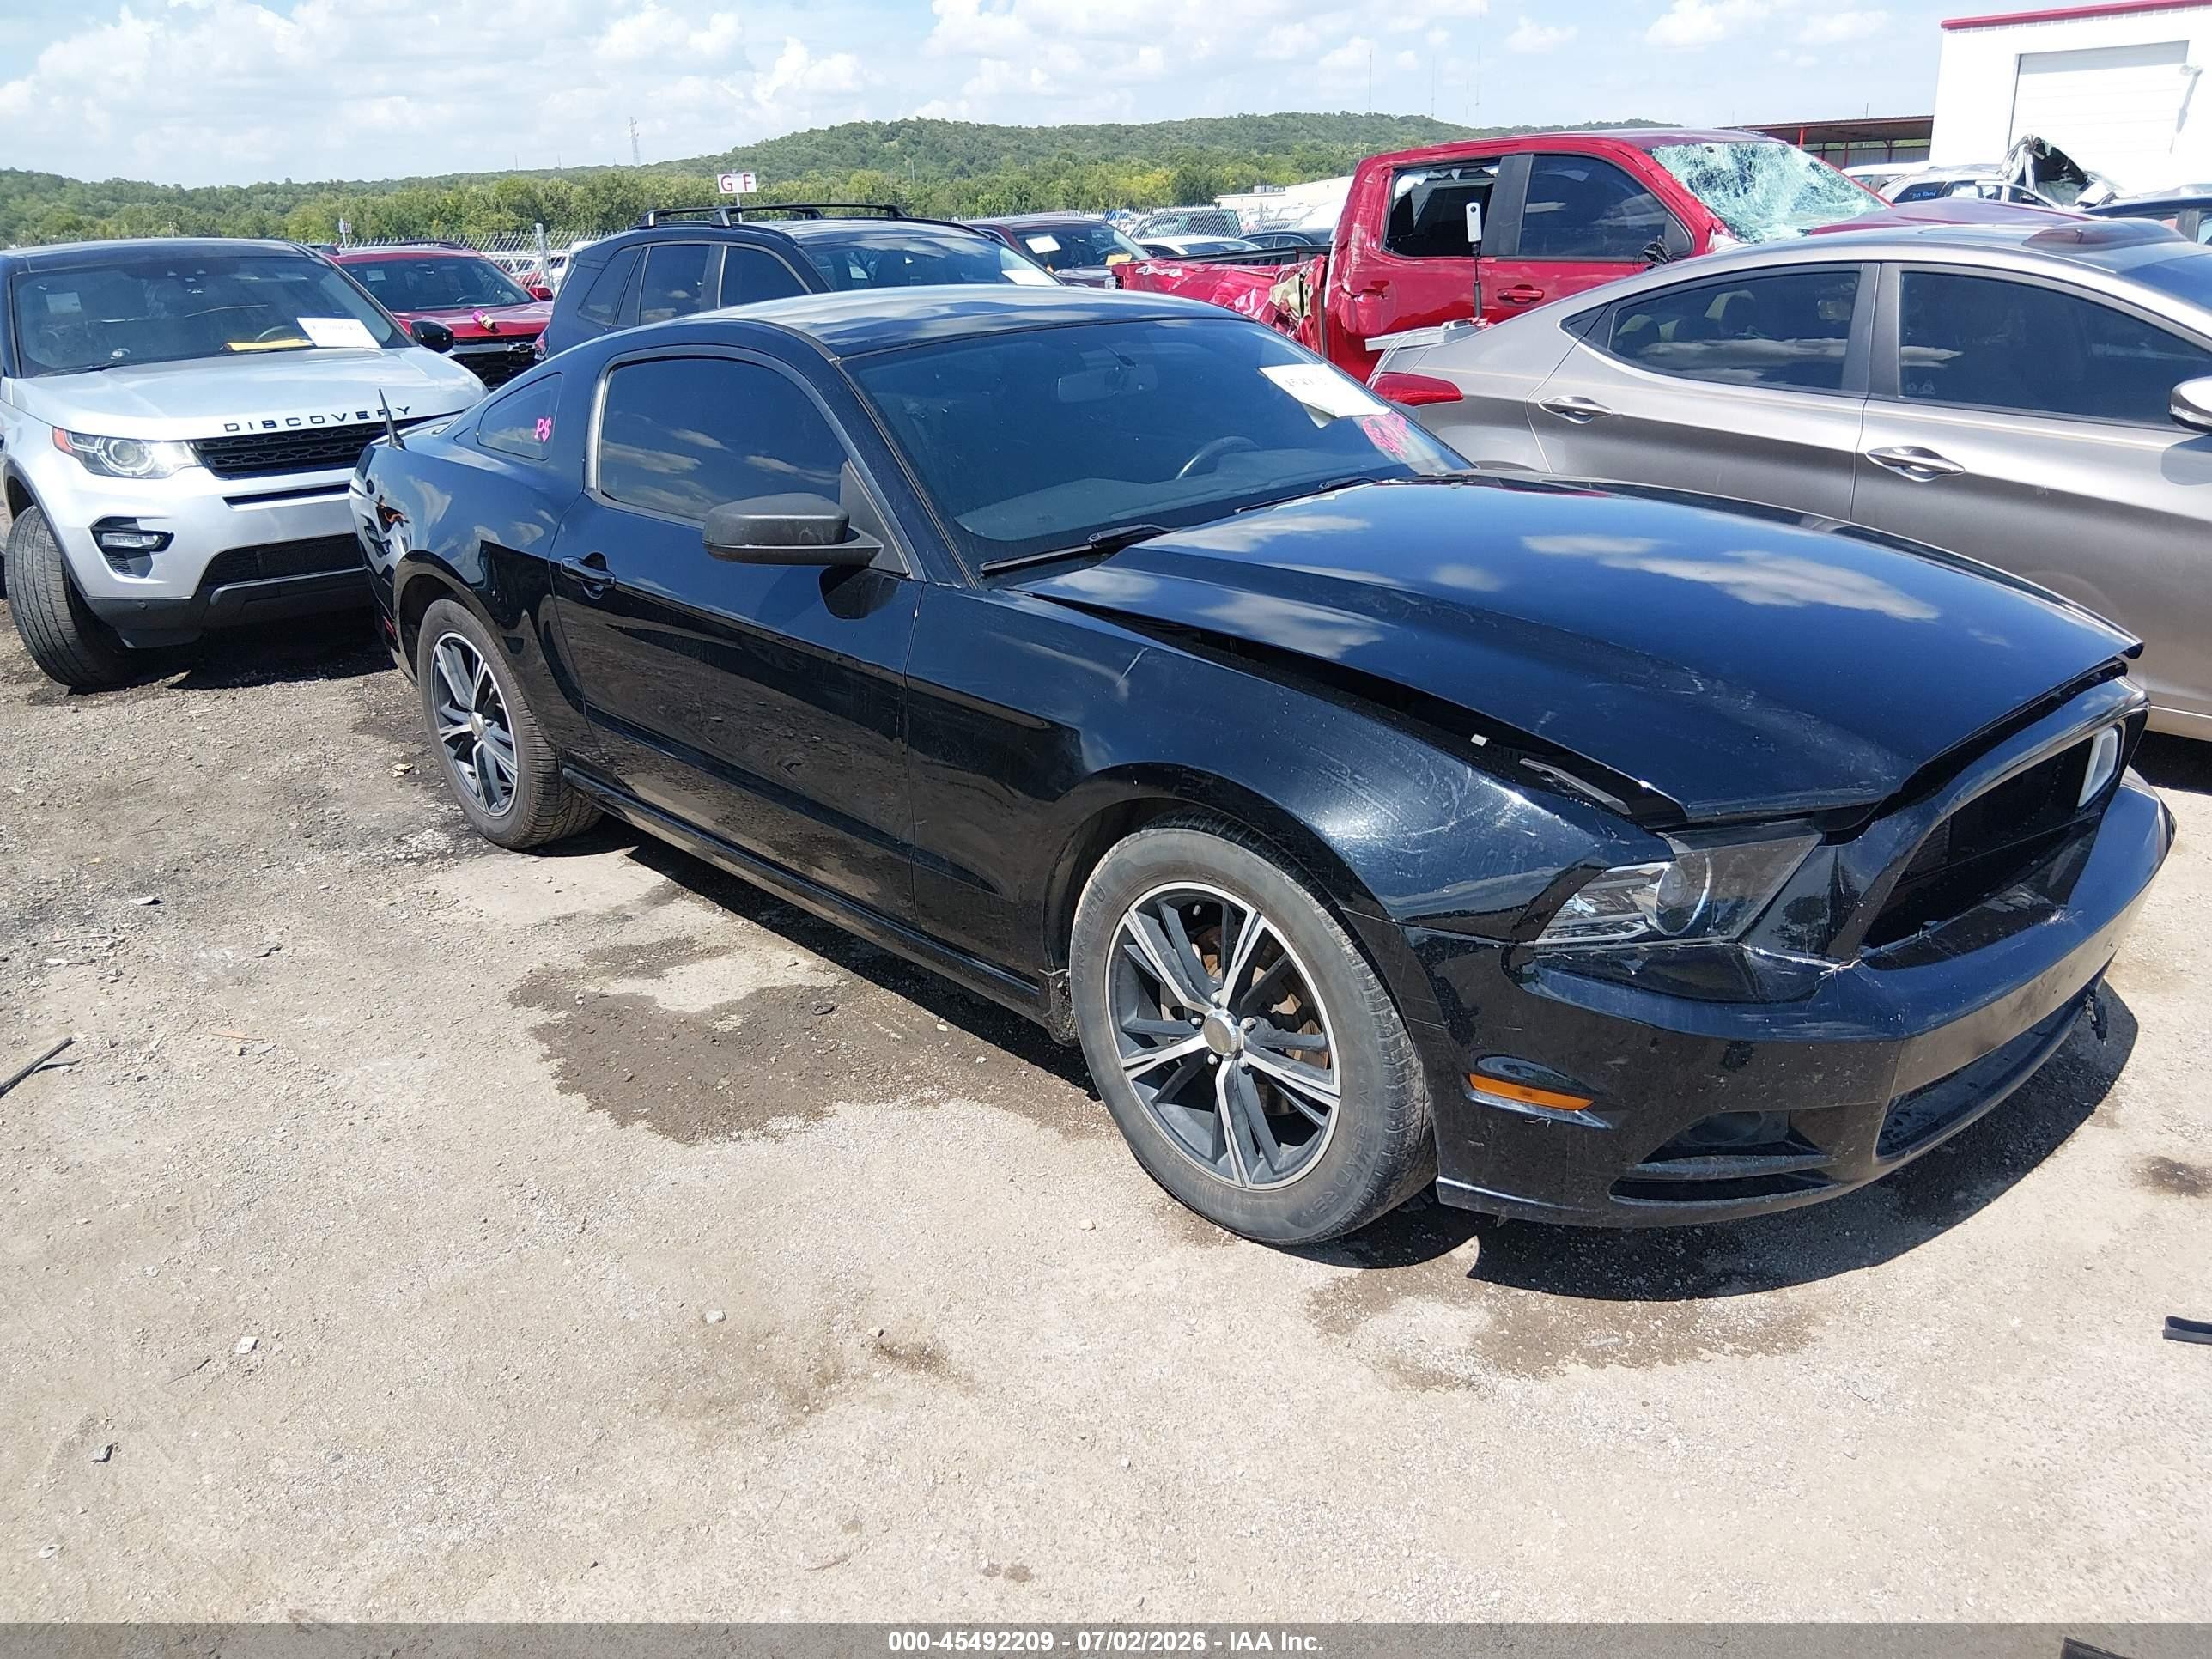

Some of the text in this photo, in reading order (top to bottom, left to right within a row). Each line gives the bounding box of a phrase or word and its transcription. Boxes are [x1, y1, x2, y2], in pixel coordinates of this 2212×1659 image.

[721, 173, 752, 192] G F
[223, 405, 410, 433] DISCOVERY
